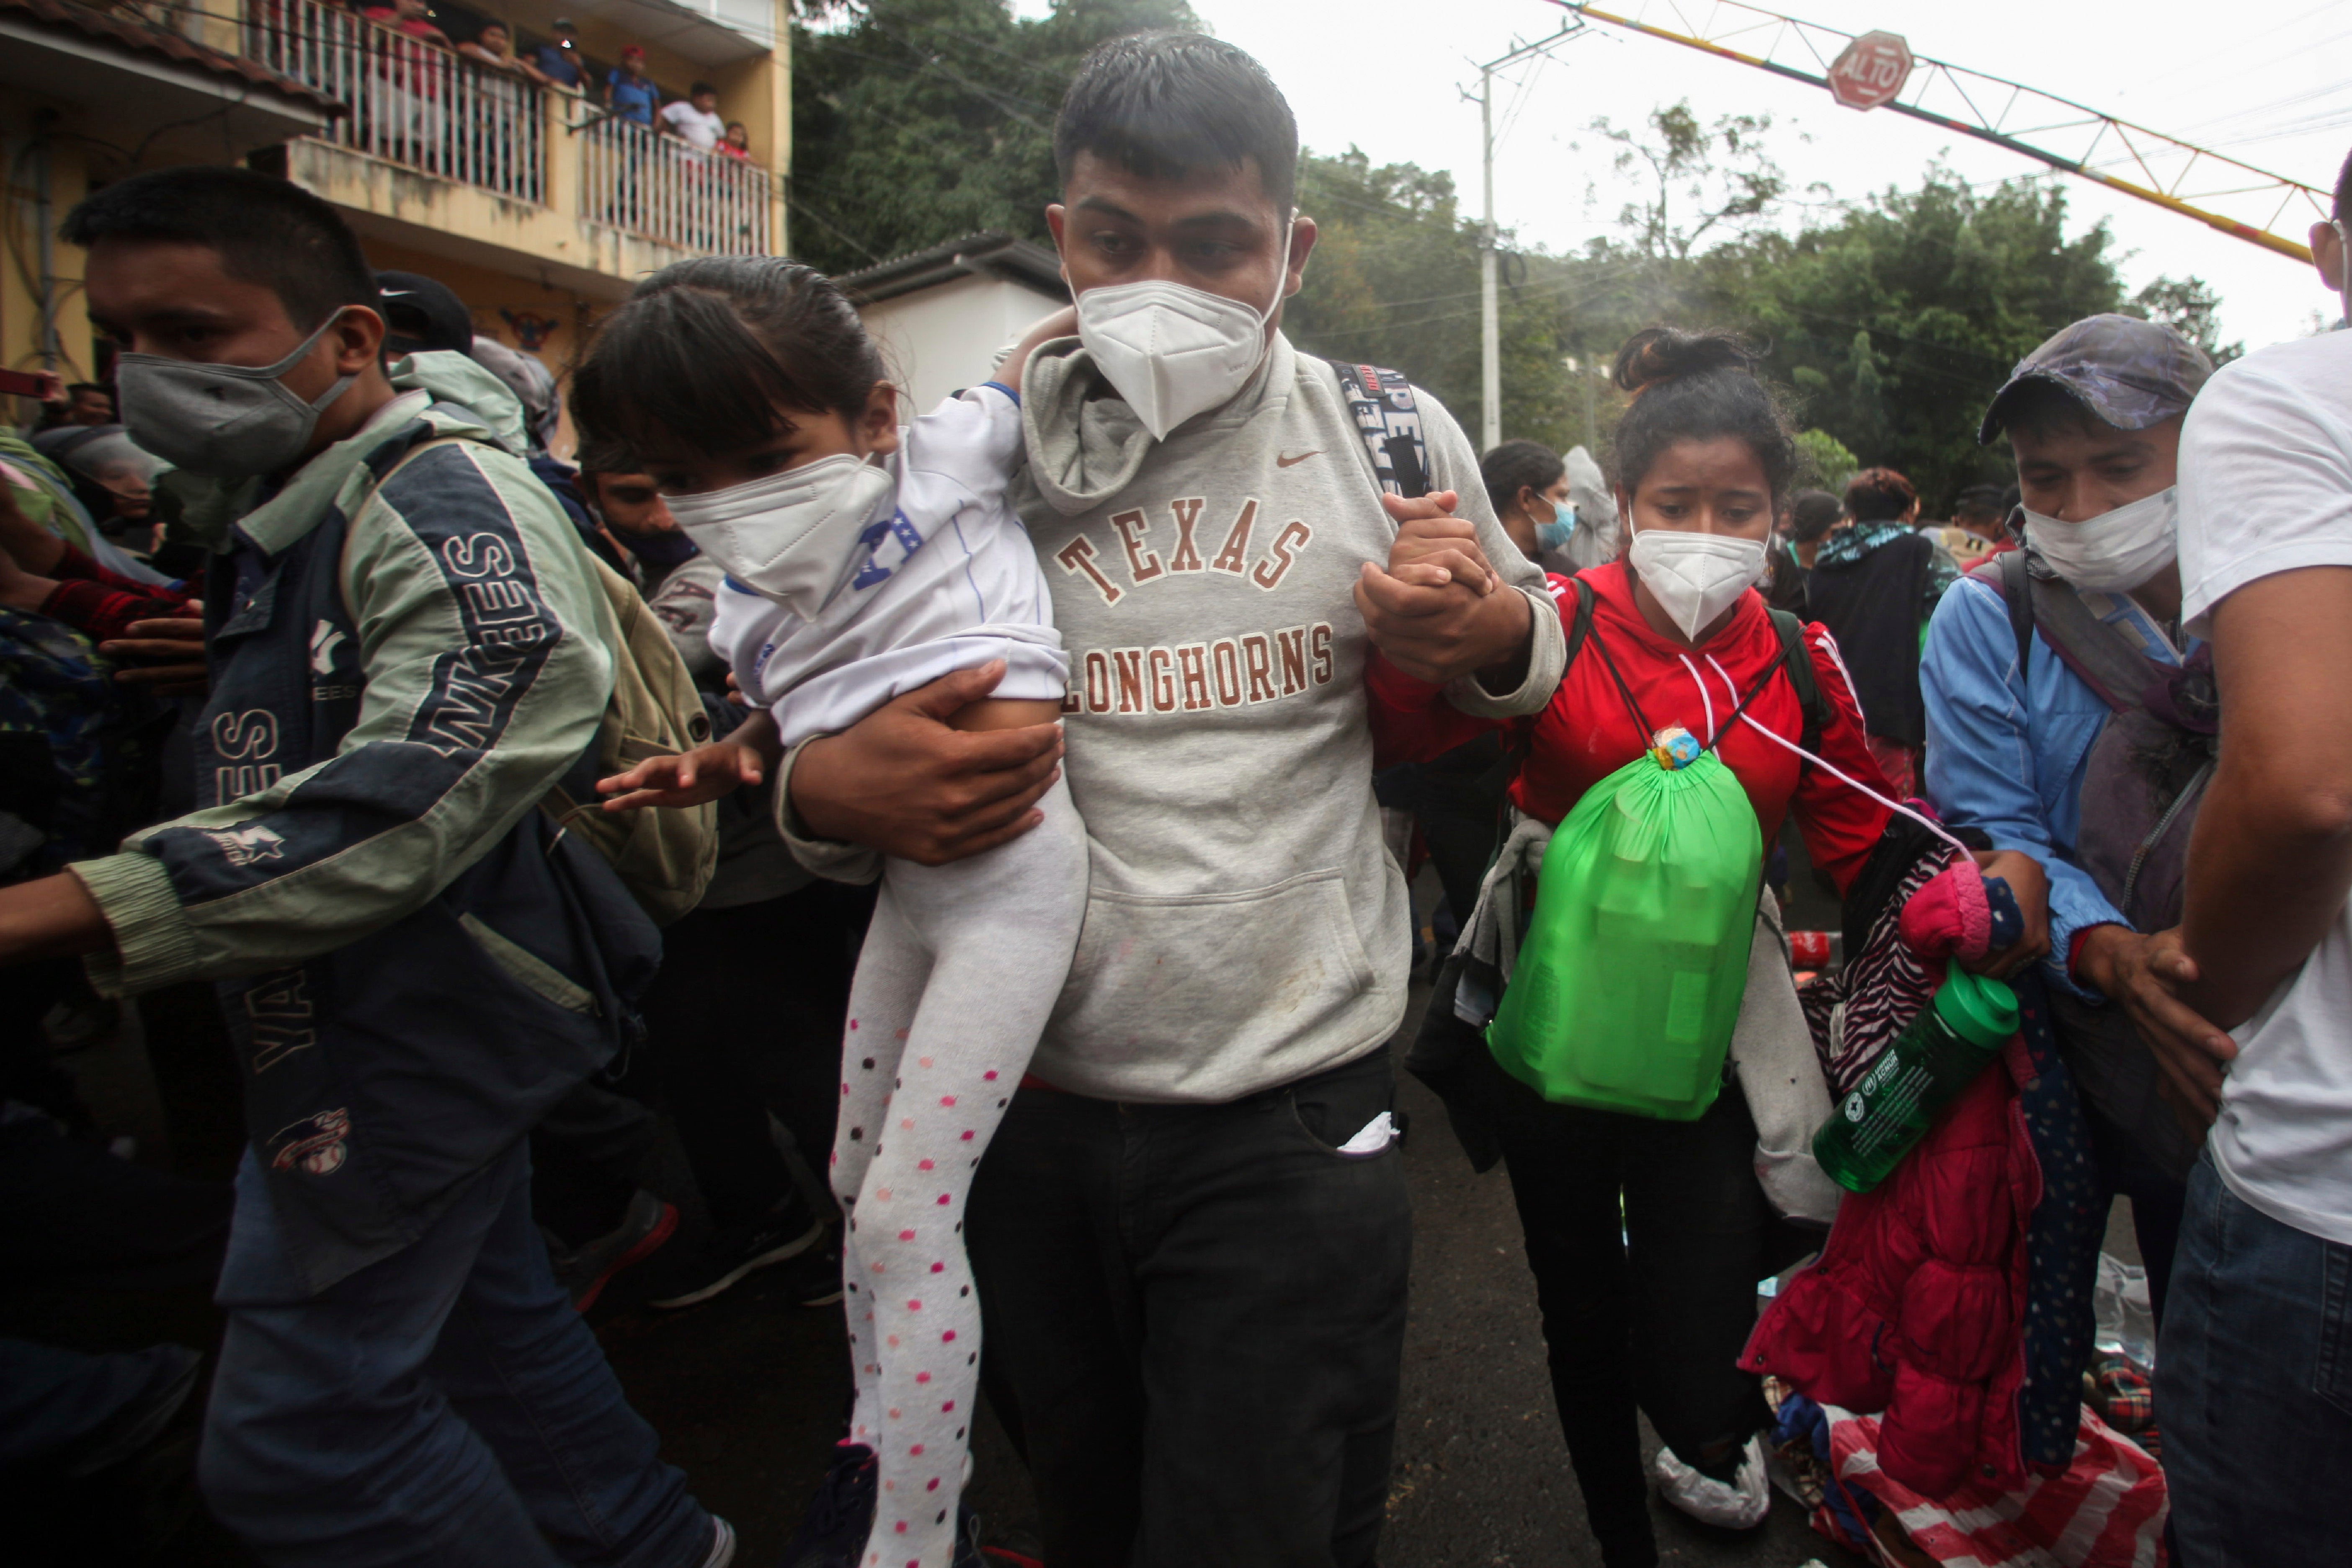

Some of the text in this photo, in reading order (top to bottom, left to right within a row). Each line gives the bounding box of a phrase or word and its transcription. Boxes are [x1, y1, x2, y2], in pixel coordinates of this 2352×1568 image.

[1839, 52, 1900, 88] ALTO
[1053, 496, 1313, 608] TEXAS
[428, 532, 546, 759] NKEES
[1874, 1049, 1896, 1075] UNHCR
[1877, 1055, 1899, 1081] ACNUR
